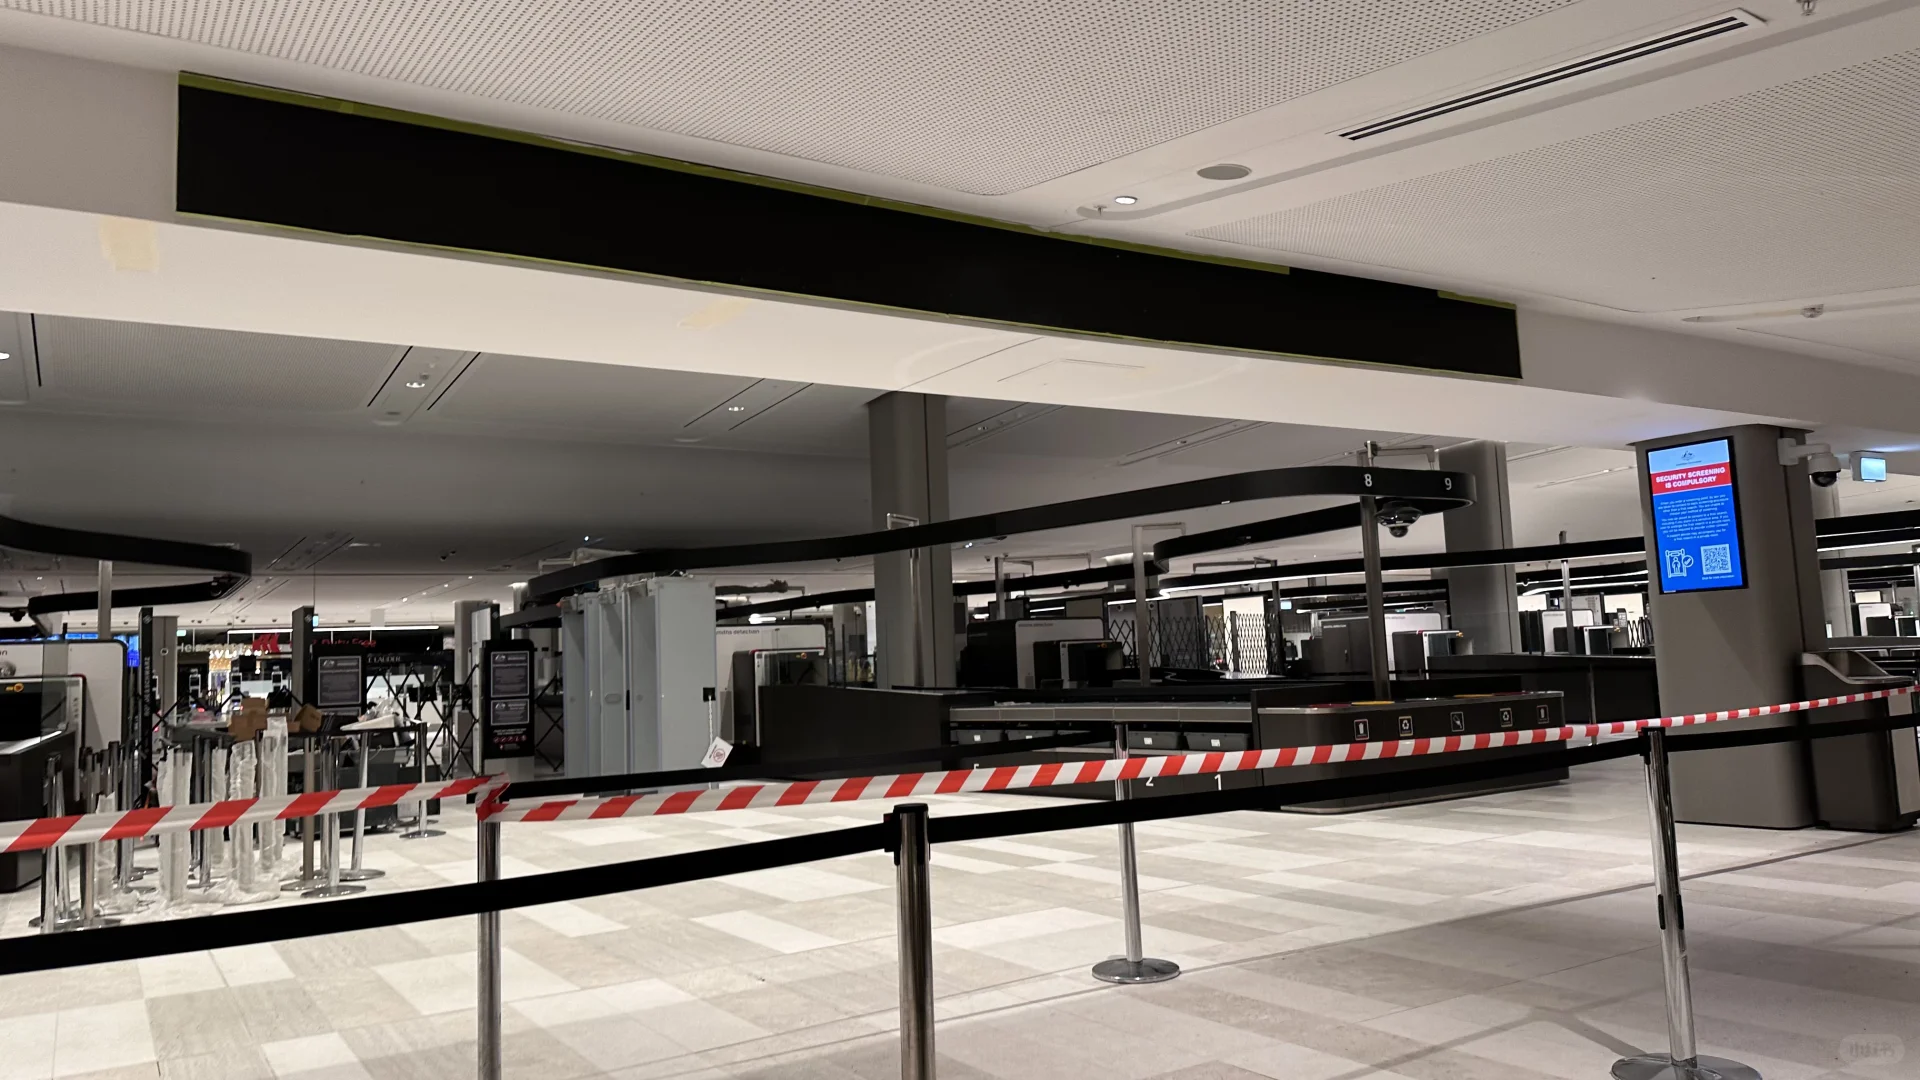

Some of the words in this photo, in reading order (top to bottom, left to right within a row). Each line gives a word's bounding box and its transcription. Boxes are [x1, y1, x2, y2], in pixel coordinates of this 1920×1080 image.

[1364, 473, 1373, 488] 8
[1655, 472, 1687, 483] SECURITY
[1687, 467, 1726, 478] SCREENING
[1665, 481, 1672, 489] IS
[1672, 476, 1717, 488] COMPULSORY
[1444, 477, 1452, 491] 9
[1214, 773, 1222, 791] 1
